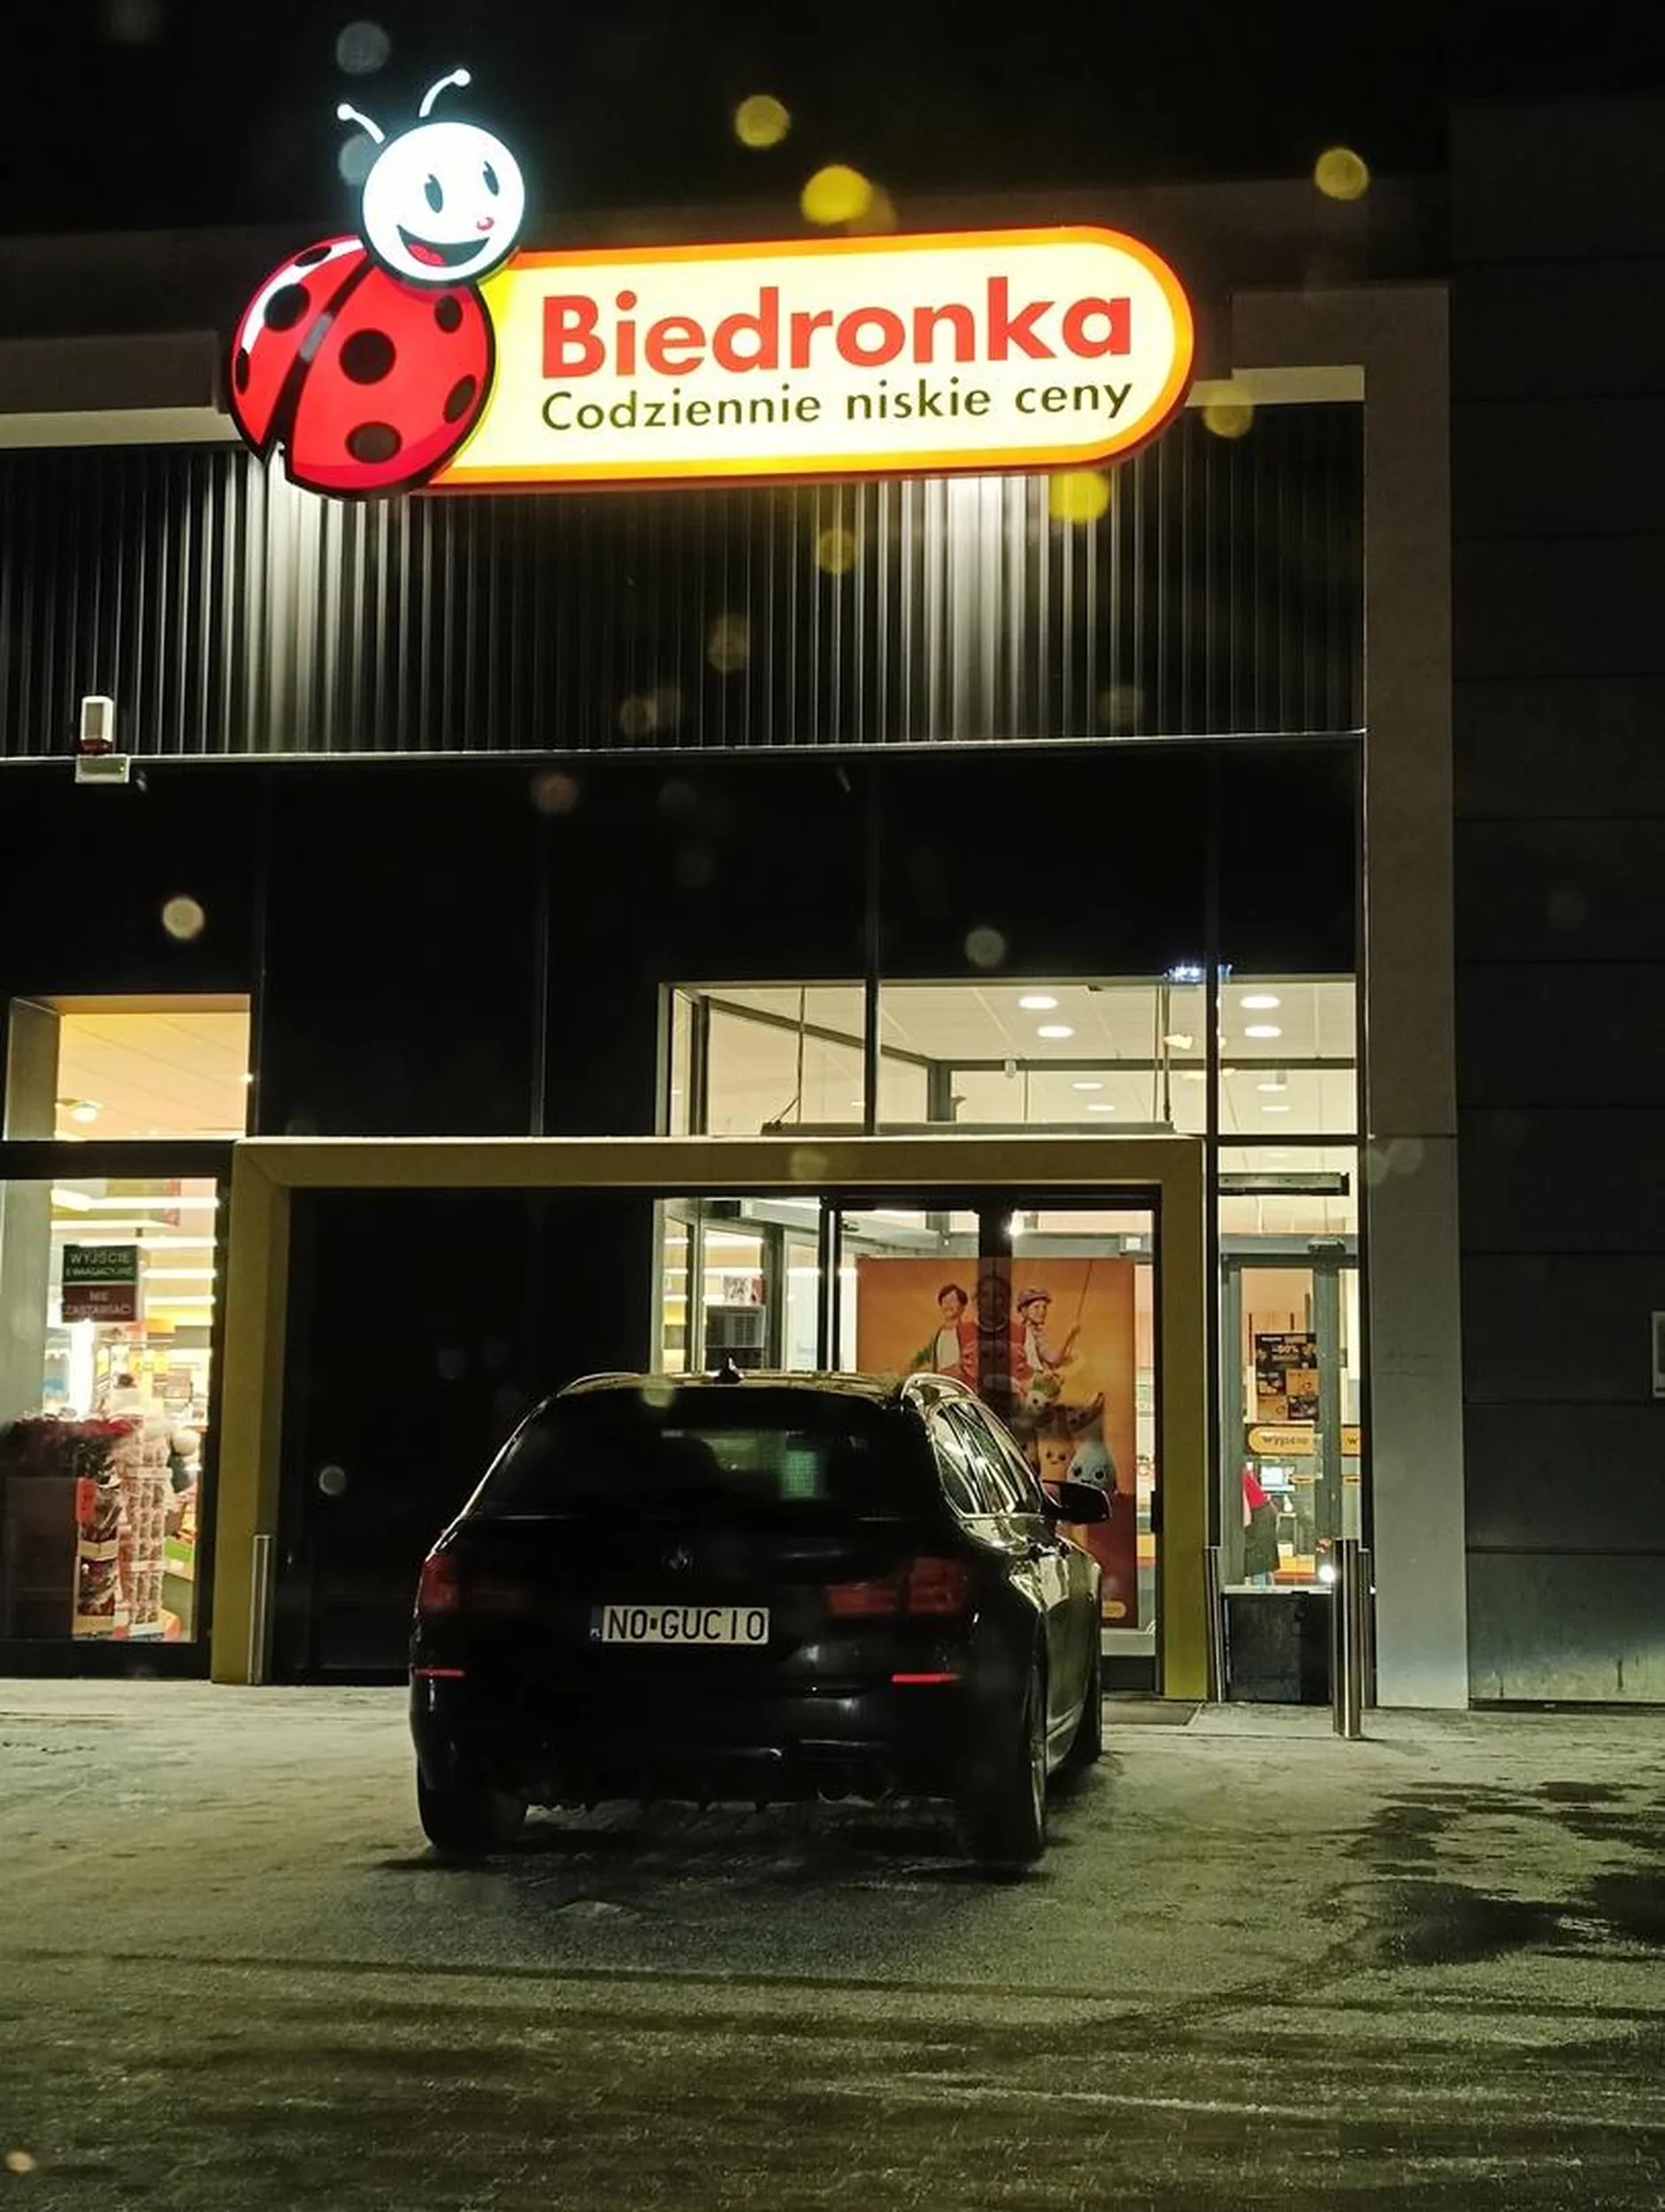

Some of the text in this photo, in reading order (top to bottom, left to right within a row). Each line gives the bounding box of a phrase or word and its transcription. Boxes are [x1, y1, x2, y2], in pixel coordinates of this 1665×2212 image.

[541, 276, 1132, 380] Biedronka
[541, 377, 1133, 431] Codziennie niskie ceny
